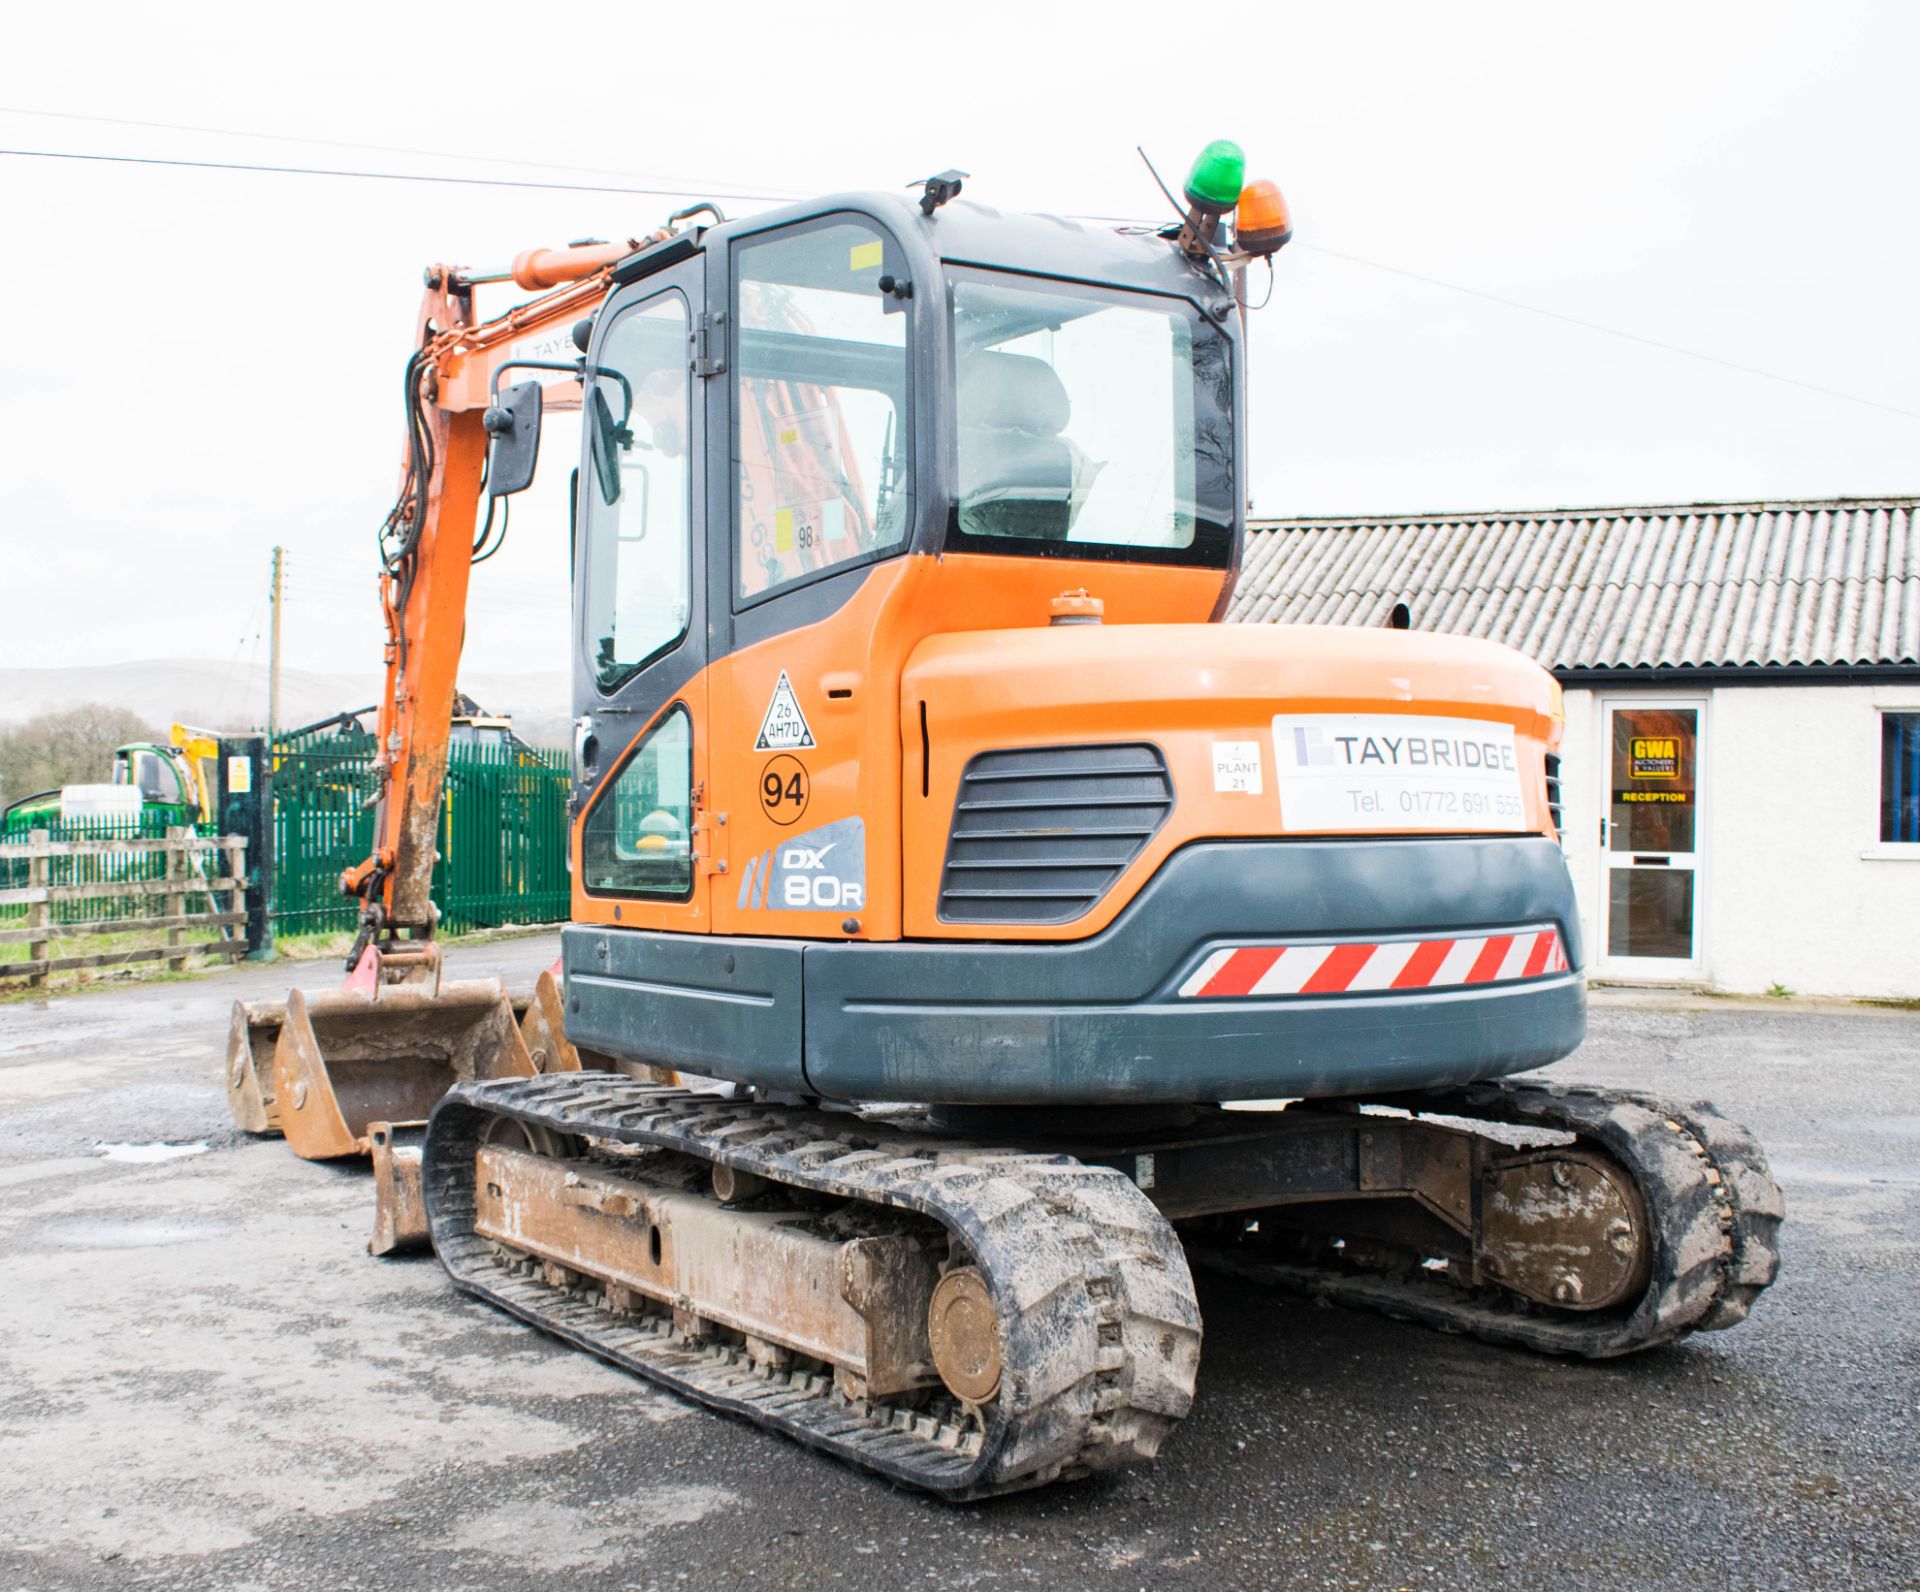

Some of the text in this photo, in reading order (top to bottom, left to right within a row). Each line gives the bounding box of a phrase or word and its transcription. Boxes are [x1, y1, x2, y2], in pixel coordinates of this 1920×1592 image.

[799, 525, 813, 550] 98
[777, 703, 792, 719] 26
[769, 721, 800, 739] AH7D
[1334, 736, 1516, 772] TAYBRIDGE
[1634, 740, 1675, 759] GWA
[1217, 762, 1258, 774] PLANT
[763, 772, 805, 808] 94
[1232, 778, 1245, 789] 21
[1346, 790, 1522, 816] Tel. 01772 691 555
[1622, 792, 1686, 801] RECEPTION
[782, 842, 838, 869] DX
[784, 875, 863, 906] 80R
